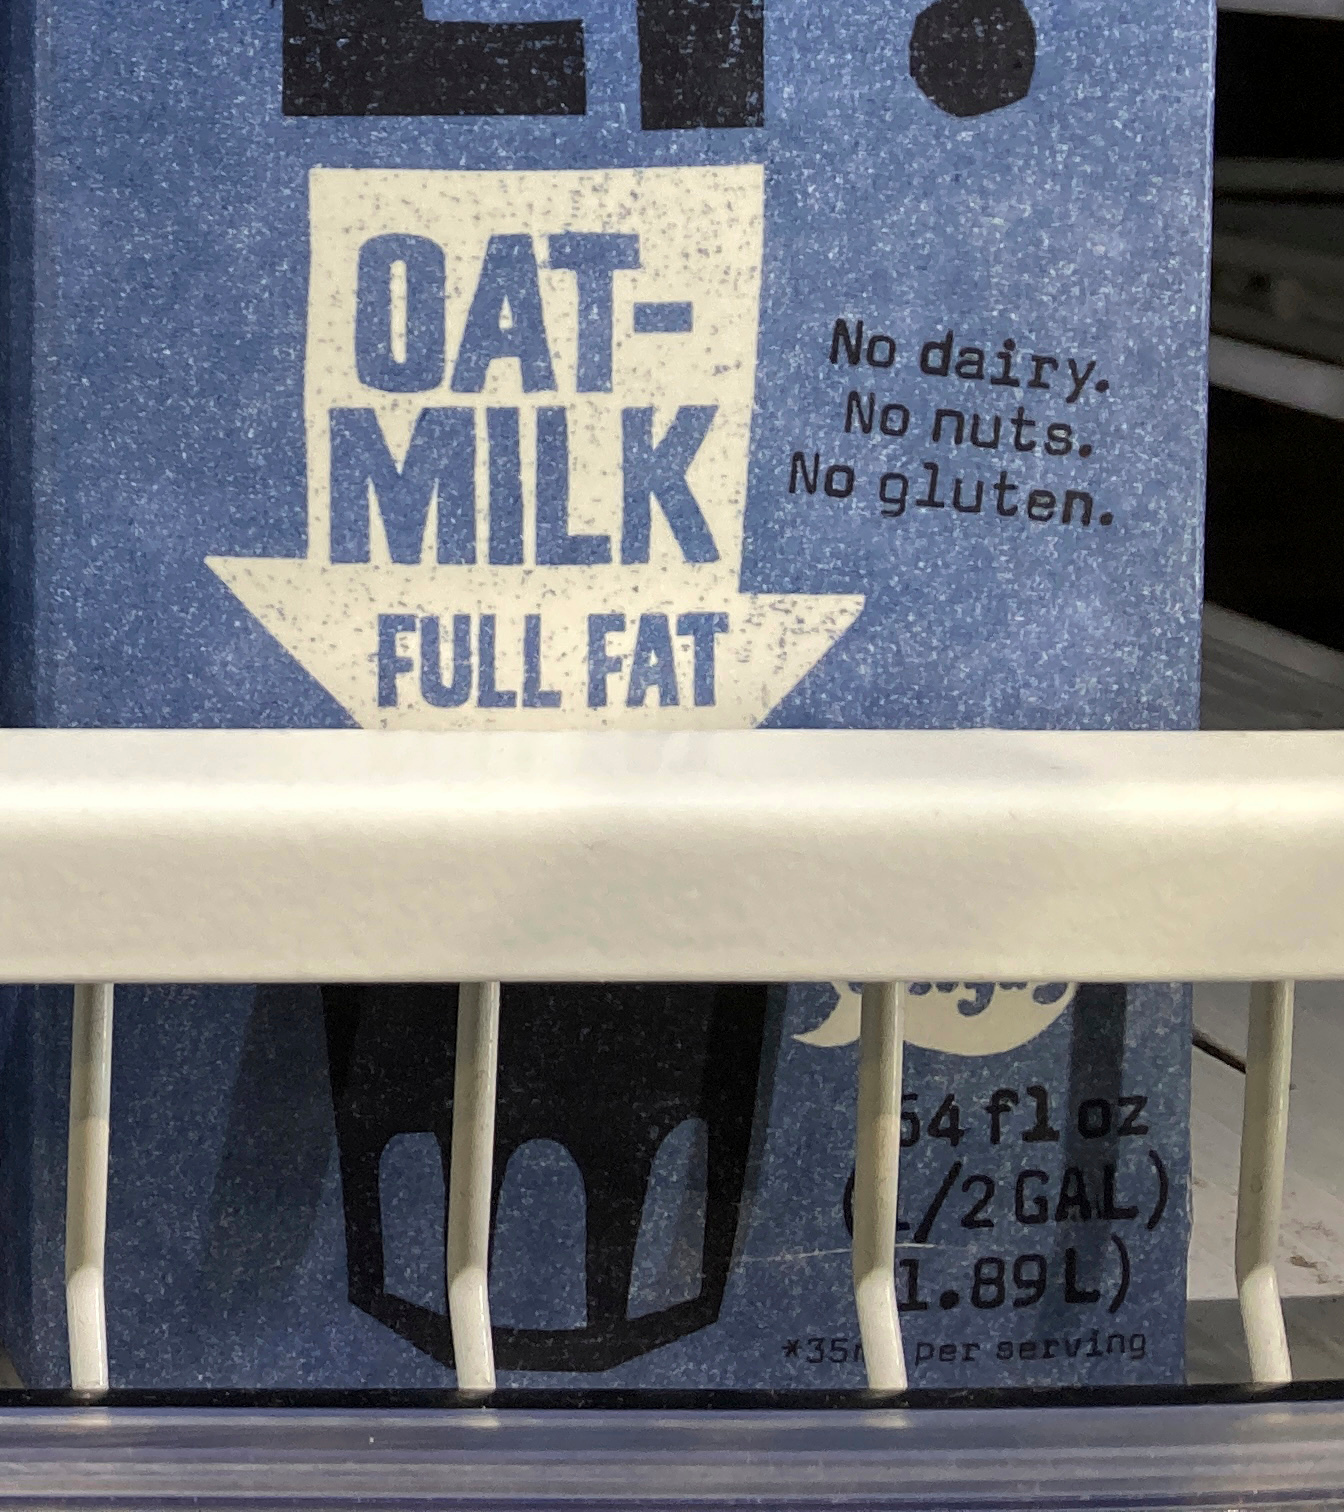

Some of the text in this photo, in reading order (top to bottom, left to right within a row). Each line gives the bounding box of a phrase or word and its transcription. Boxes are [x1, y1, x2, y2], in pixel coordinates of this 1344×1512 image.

[355, 231, 694, 394] OAT-
[829, 317, 1110, 404] No dairy.
[844, 390, 1092, 458] No nuts.
[328, 404, 722, 565] MILK
[789, 450, 1113, 527] No gluten.
[377, 611, 729, 708] FULL FAT
[984, 1085, 1060, 1145] fl
[1077, 1095, 1149, 1141] oz
[1014, 1149, 1170, 1230] GAL)
[915, 1328, 1147, 1366] per serving
